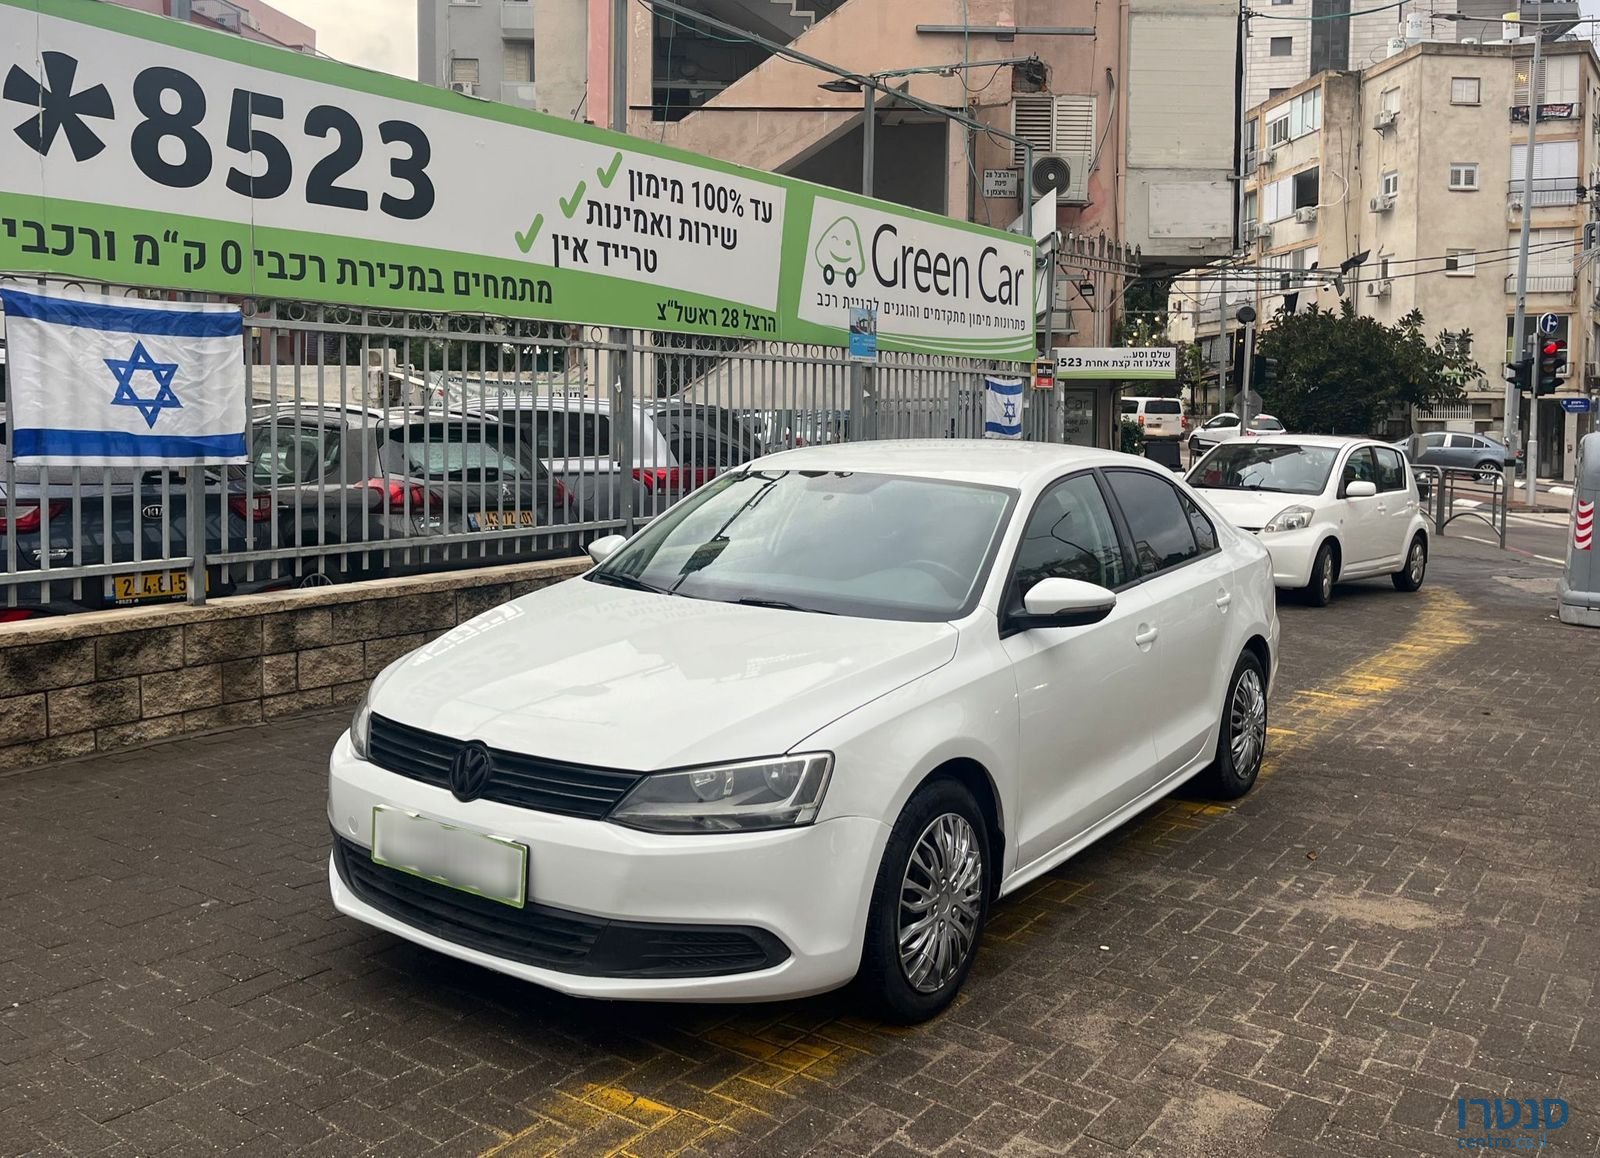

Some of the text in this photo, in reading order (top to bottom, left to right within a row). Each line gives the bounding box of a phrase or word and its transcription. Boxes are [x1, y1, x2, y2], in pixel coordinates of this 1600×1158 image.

[628, 169, 773, 224] עד 100% מימון
[586, 199, 738, 250] שירות ואמינות
[2, 217, 116, 261] ורכבי
[552, 233, 658, 273] טרייד אין
[254, 250, 326, 282] רכבי
[872, 224, 1025, 306] Green Car
[337, 258, 445, 294] במכירת
[454, 271, 552, 304] מתמחים
[817, 292, 838, 307] רכב
[721, 307, 739, 328] 28
[743, 307, 776, 333] הרצל
[884, 302, 919, 318] והוגנים
[923, 307, 965, 326] מתקדמים
[969, 312, 991, 328] מימון
[994, 317, 1026, 331] פתרונות
[1085, 360, 1109, 368] אחרת
[1112, 360, 1130, 370] קצת
[1133, 360, 1143, 368] זה
[1145, 359, 1171, 368] אצלנו
[1150, 351, 1171, 360] שלם
